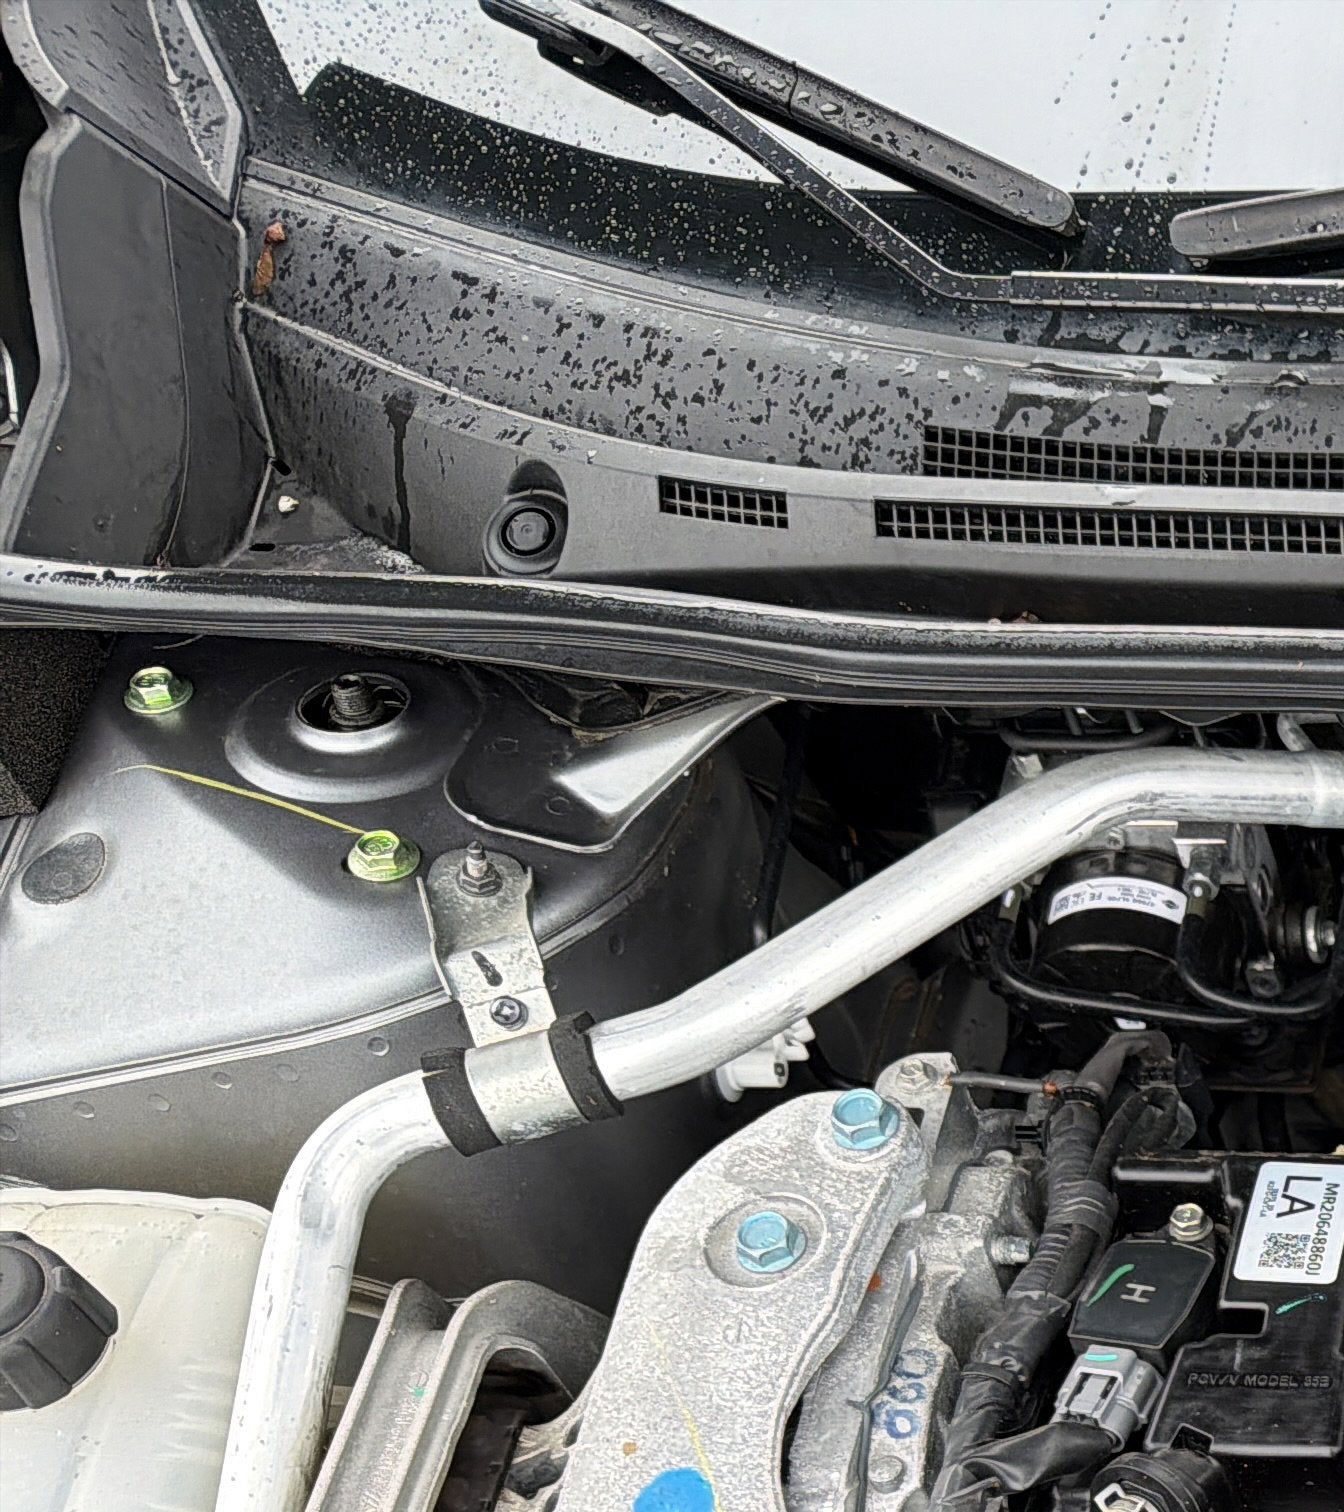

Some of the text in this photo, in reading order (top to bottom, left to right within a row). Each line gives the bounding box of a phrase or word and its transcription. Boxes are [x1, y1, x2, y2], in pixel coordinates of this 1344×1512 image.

[1275, 1175, 1323, 1218] LA
[1305, 1182, 1340, 1275] MR20648860J
[1244, 1374, 1299, 1387] MODEL
